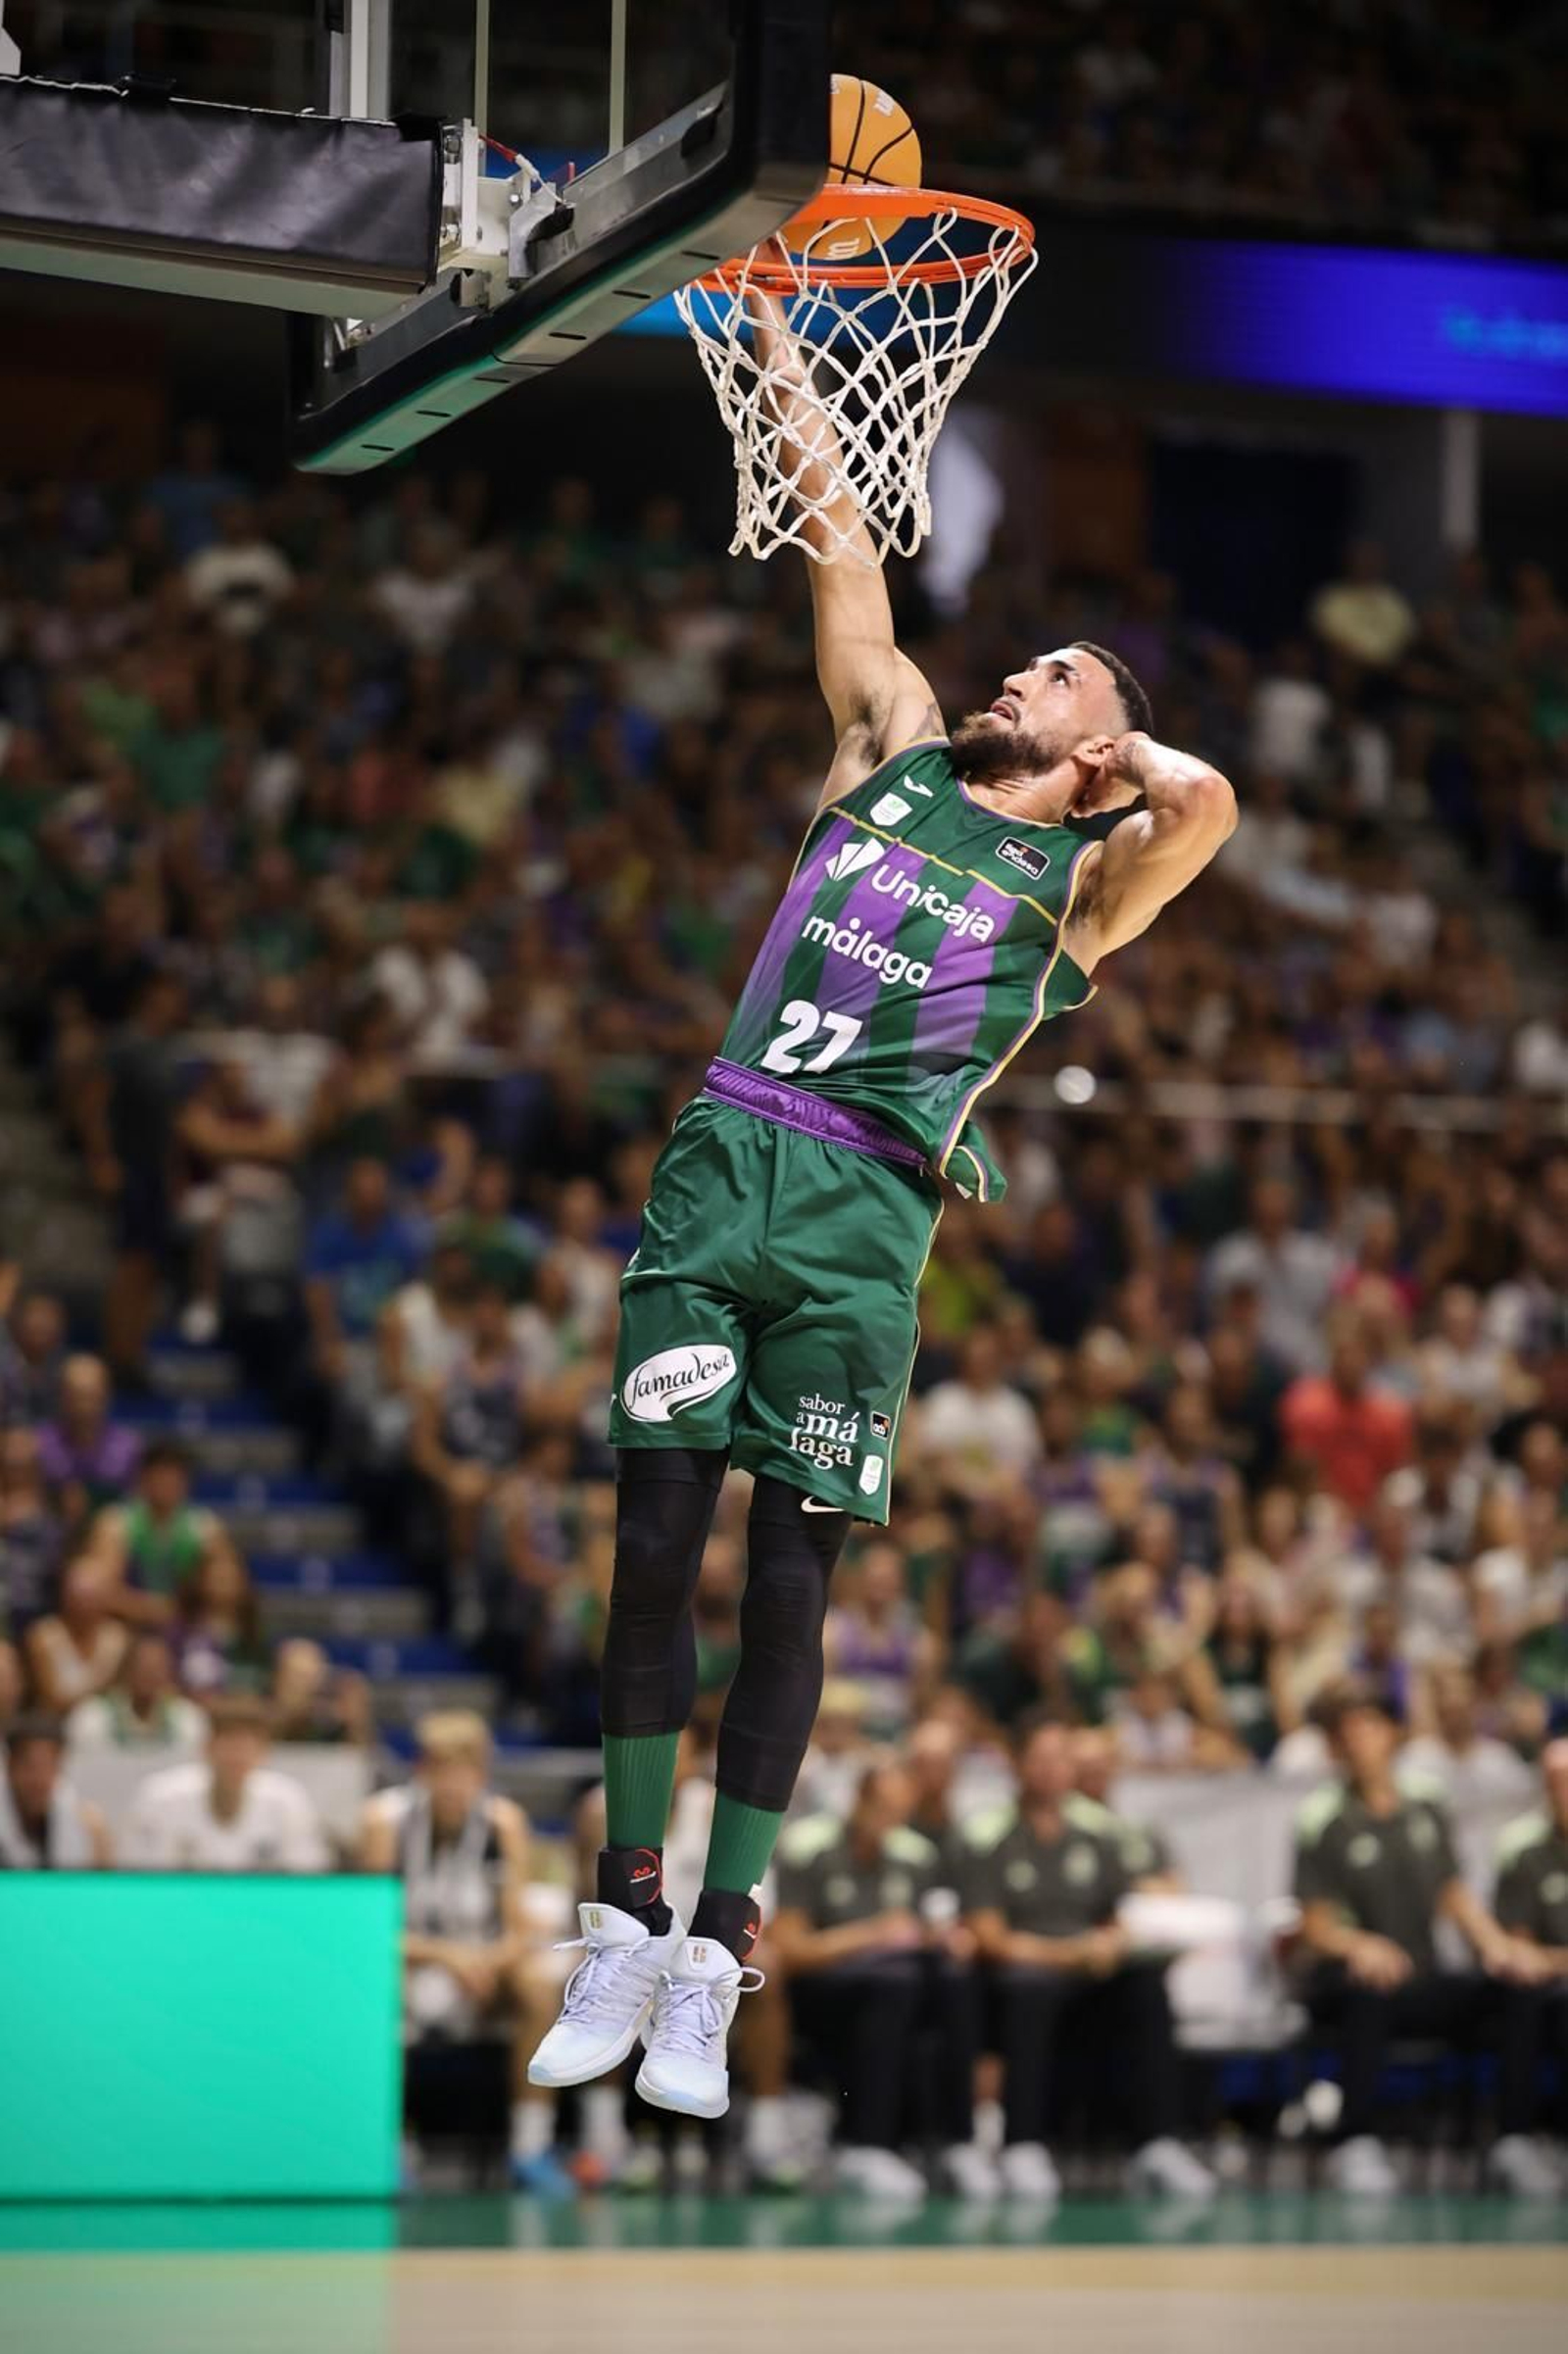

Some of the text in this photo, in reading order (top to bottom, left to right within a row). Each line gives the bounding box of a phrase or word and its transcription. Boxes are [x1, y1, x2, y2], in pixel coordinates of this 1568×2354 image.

[870, 863, 996, 944] Unicaja
[760, 1000, 864, 1074] 27
[628, 1352, 730, 1409] famadesa
[799, 1393, 845, 1415] sabor
[788, 1428, 854, 1470] laga
[806, 1411, 859, 1445] má
